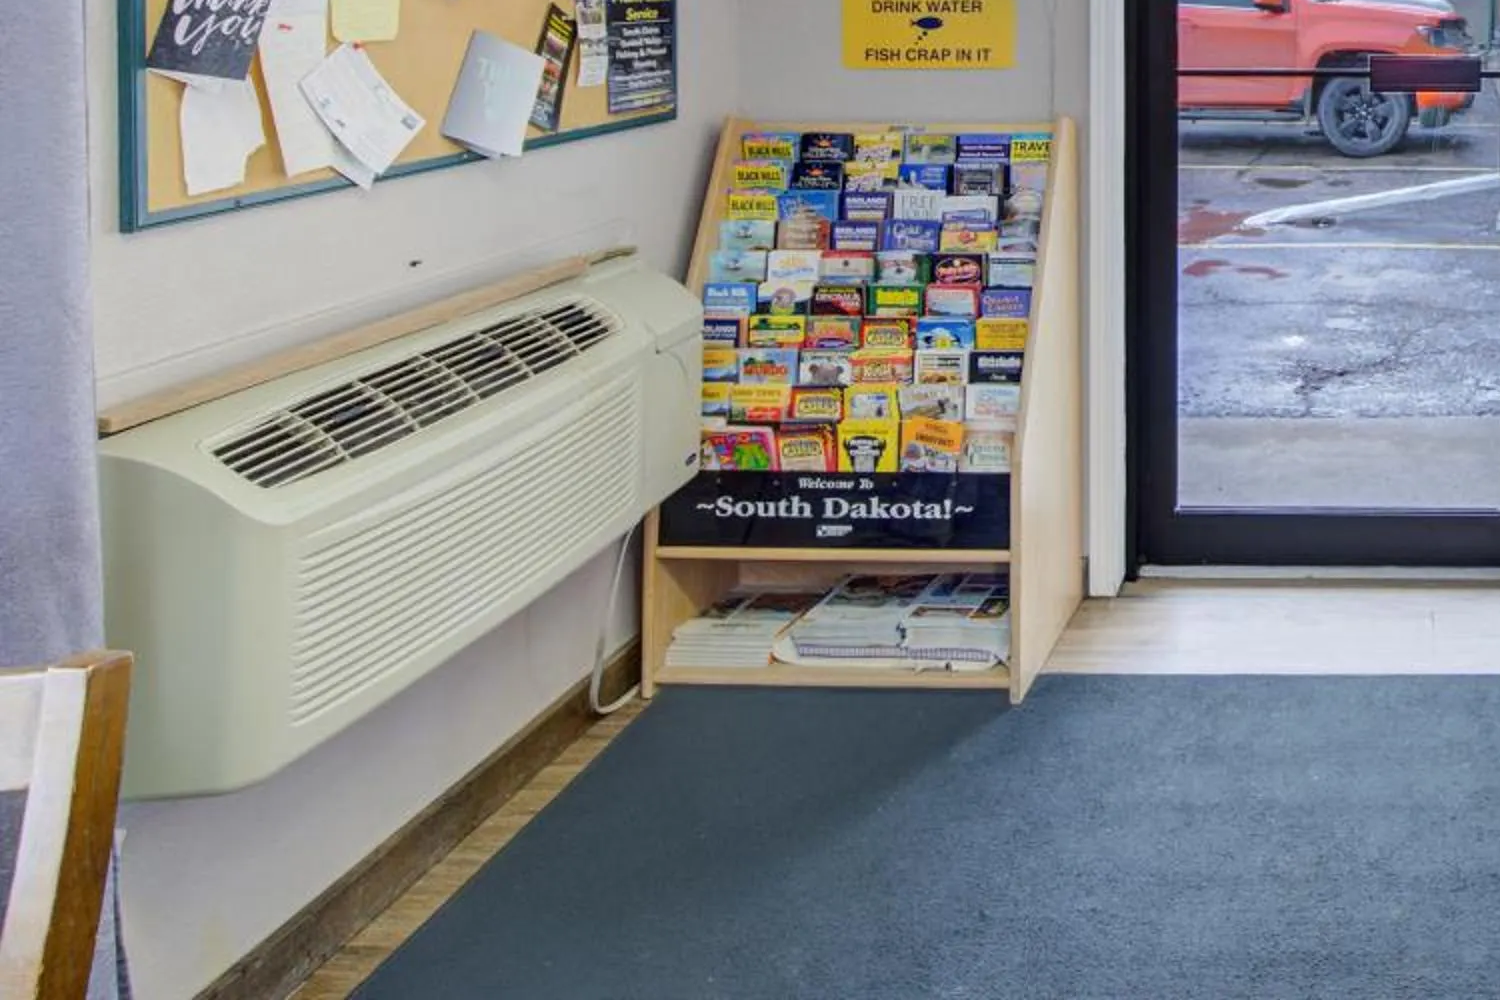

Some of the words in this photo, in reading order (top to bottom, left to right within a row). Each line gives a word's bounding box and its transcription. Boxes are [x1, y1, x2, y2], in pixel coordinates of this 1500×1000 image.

[871, 0, 922, 13] DRINK
[926, 0, 983, 13] WATER
[173, 14, 262, 55] you
[864, 49, 901, 62] FISH
[905, 49, 951, 62] CRAP
[956, 49, 971, 61] IN
[977, 49, 991, 61] IT
[1014, 140, 1049, 152] TRAVE
[798, 477, 854, 489] Welcome
